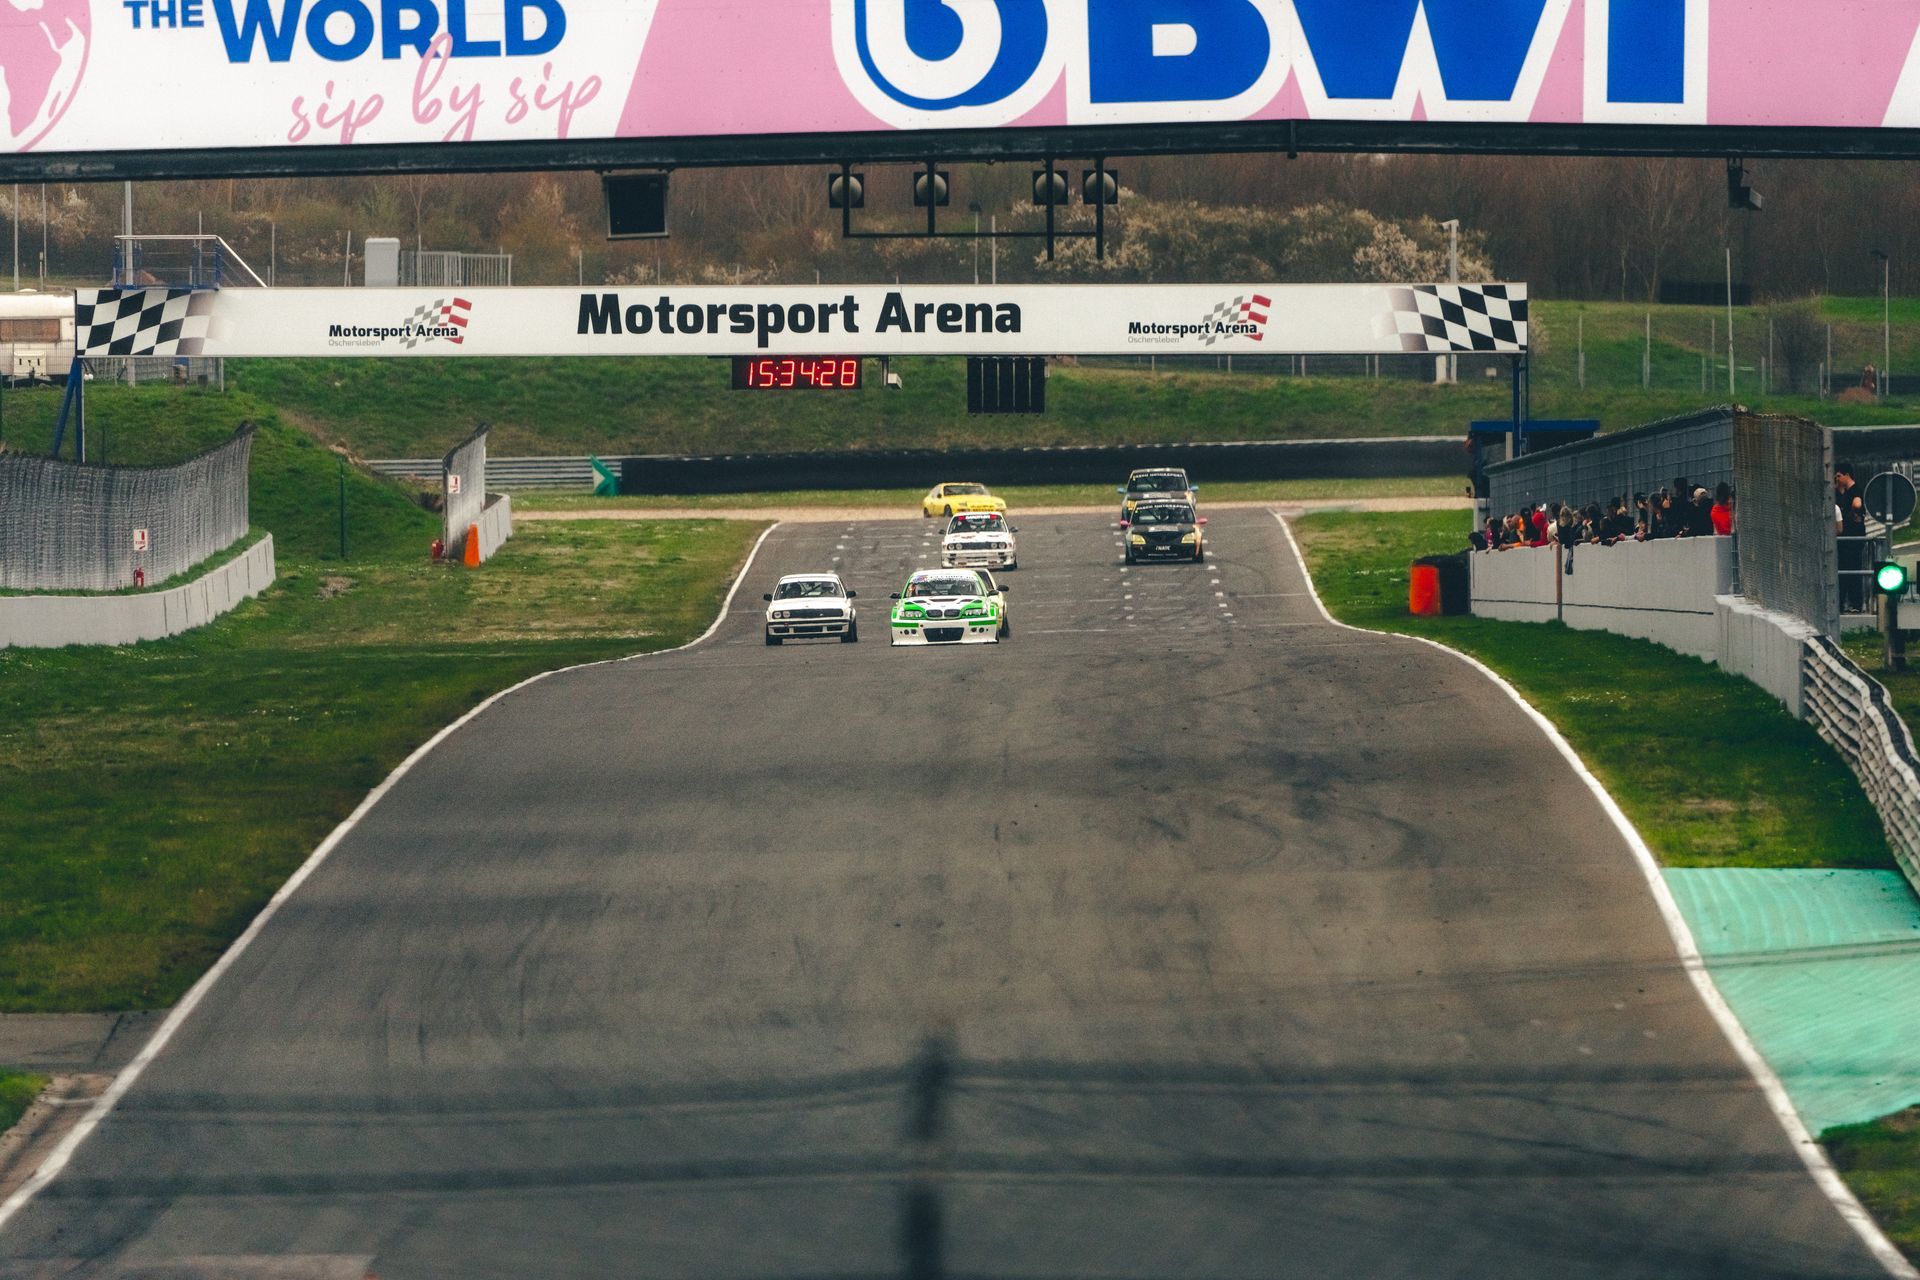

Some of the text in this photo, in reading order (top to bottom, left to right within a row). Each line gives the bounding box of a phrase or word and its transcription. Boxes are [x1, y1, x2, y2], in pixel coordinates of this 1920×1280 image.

[123, 0, 567, 63] THE WORLD
[287, 32, 602, 144] sip by sip
[577, 292, 1022, 348] Motorsport Arena
[1128, 321, 1257, 338] Motorsport Arena
[328, 324, 458, 341] Motorsport Arena
[328, 339, 381, 347] Oschersleben
[1127, 335, 1180, 344] Oschersleben
[748, 360, 857, 387] 15:34:28
